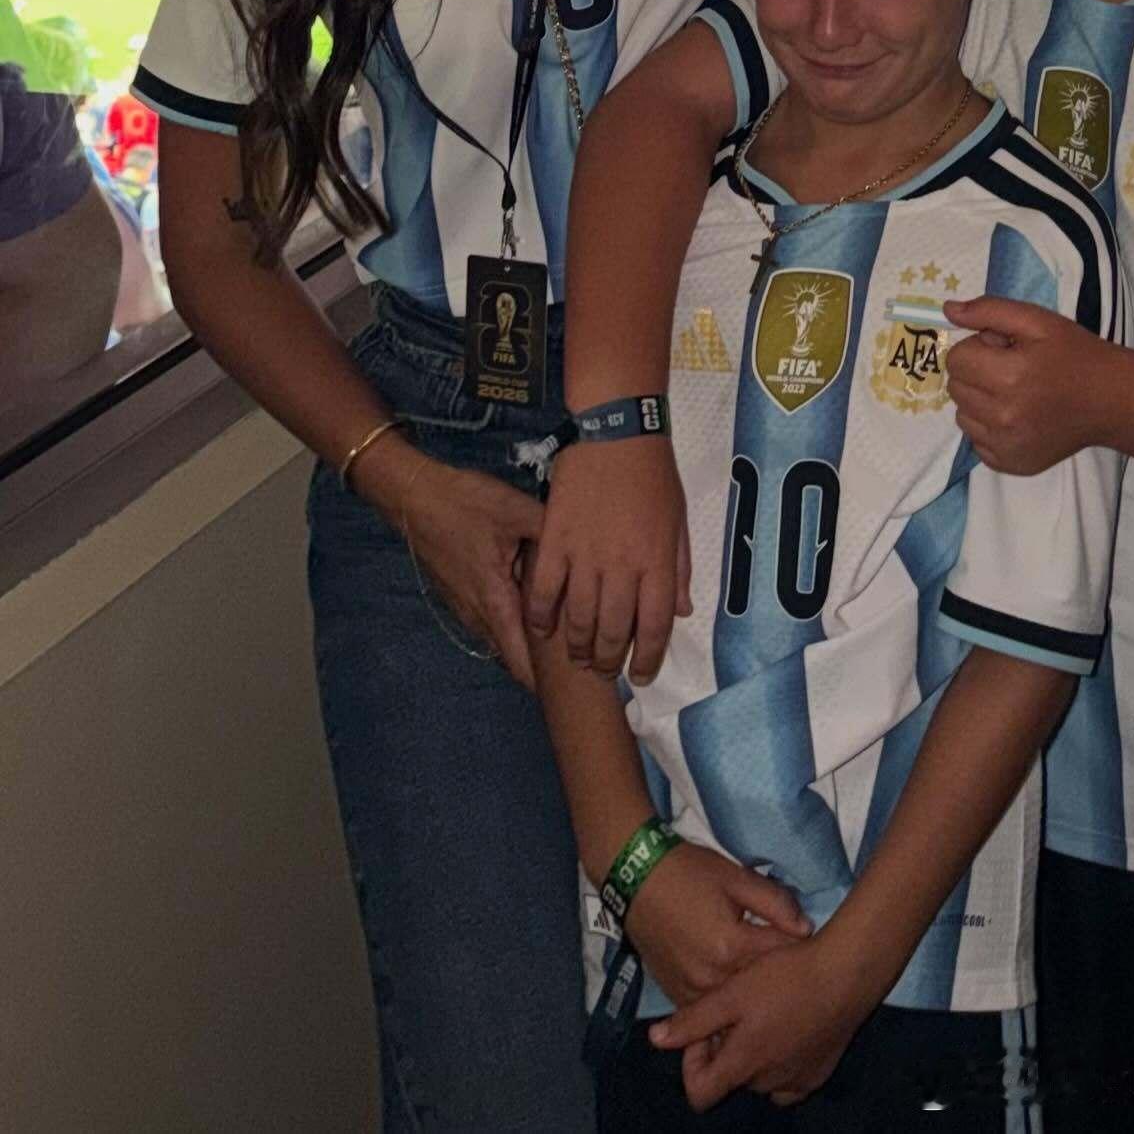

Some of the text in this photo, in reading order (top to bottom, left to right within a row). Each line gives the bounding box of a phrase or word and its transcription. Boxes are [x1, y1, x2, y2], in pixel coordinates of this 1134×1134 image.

[1059, 146, 1093, 170] FIFA
[493, 352, 515, 363] FIFA
[777, 358, 817, 377] FIFA
[888, 324, 941, 380] AFA
[723, 455, 840, 620] 10
[618, 840, 652, 885] ALG
